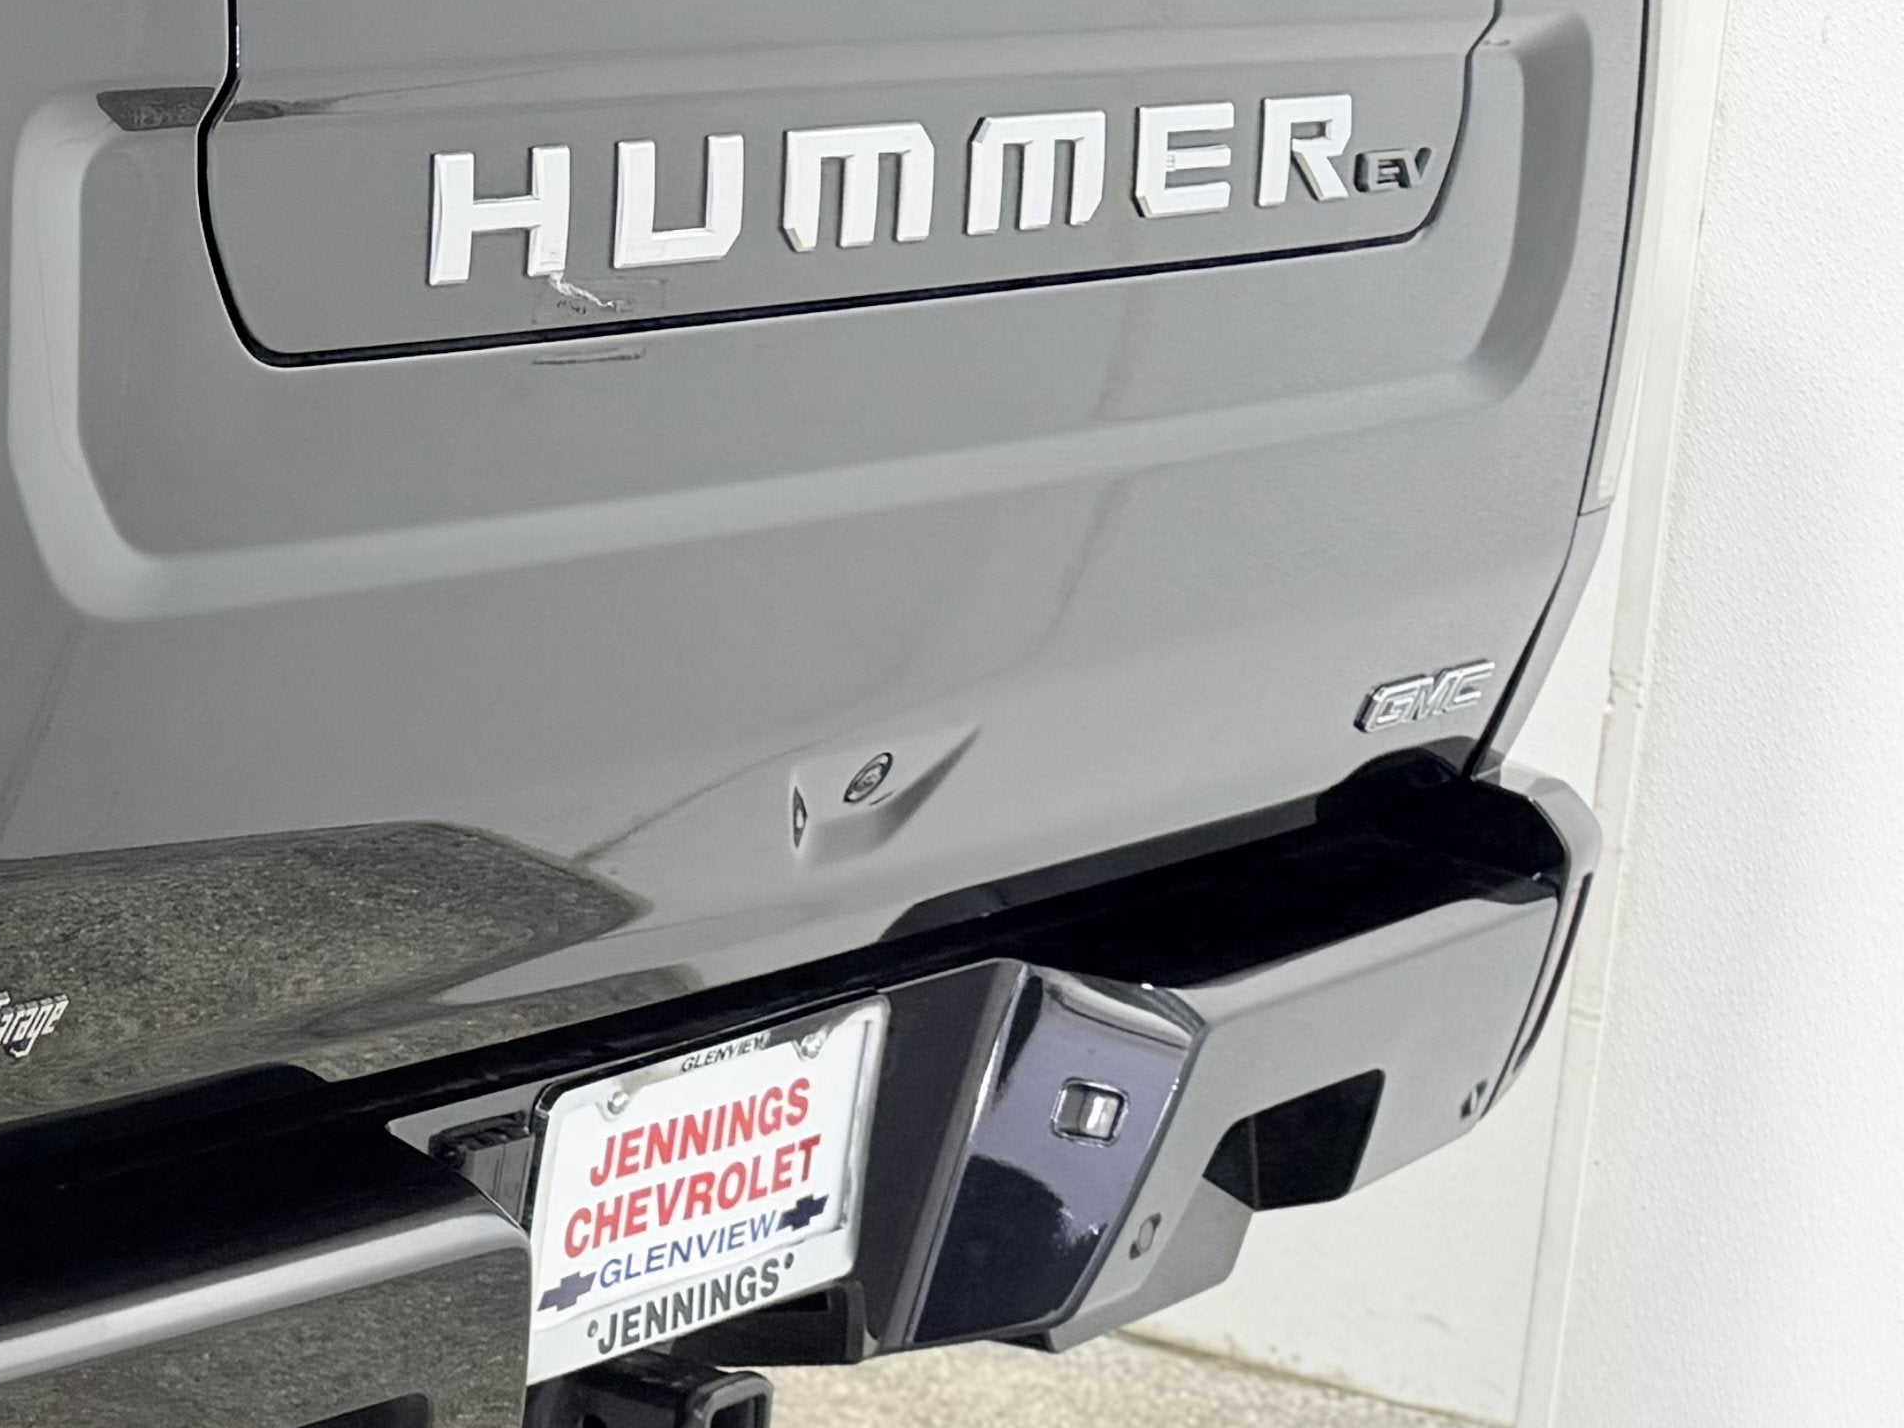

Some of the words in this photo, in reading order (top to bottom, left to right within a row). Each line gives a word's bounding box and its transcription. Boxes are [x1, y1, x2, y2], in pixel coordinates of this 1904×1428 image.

[427, 94, 1353, 286] HUMMER
[1352, 145, 1434, 194] EV
[1354, 659, 1495, 733] GMC
[680, 1029, 773, 1073] GLENVIEW
[589, 1077, 811, 1187] JENNINGS
[564, 1134, 821, 1258] CHEVROLET
[598, 1210, 778, 1289] GLENVIEW
[597, 1258, 780, 1355] JENNINGS
